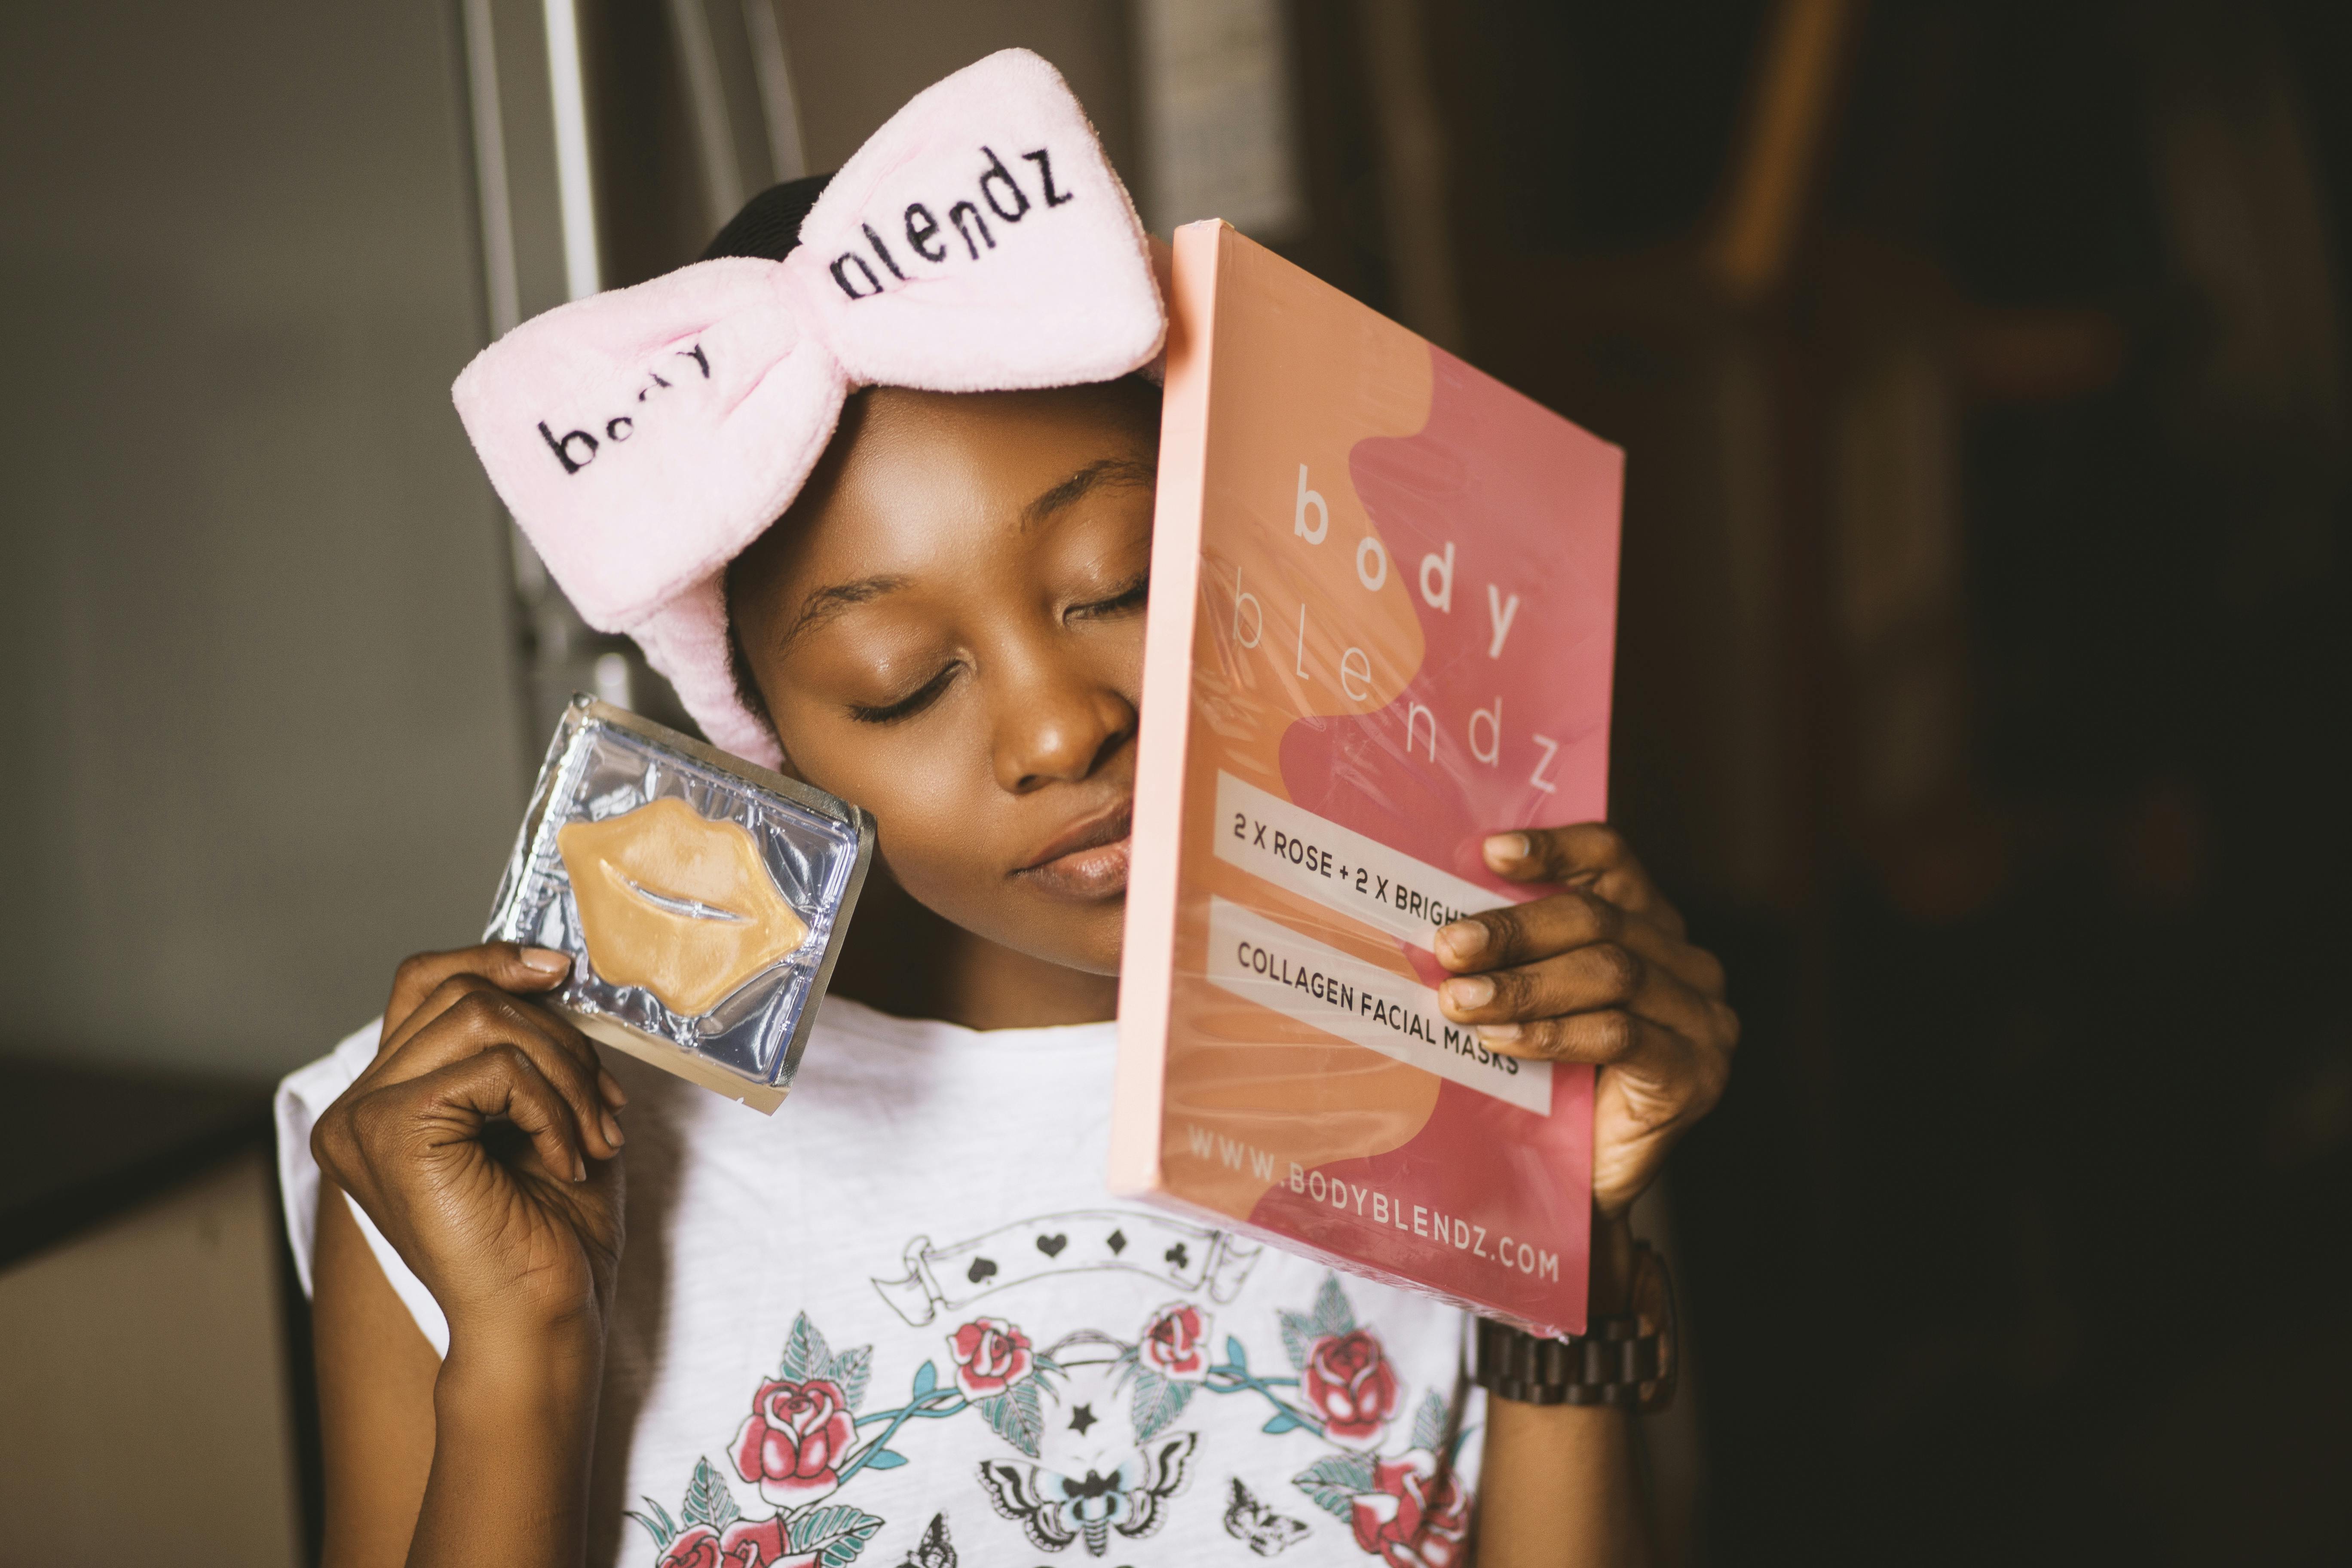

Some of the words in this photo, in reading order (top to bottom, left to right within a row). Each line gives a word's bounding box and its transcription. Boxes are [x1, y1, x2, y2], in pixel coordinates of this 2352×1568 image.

[1294, 463, 1520, 658] body
[1232, 566, 1559, 793] blendz
[1234, 812, 1246, 839] 2
[1253, 821, 1267, 849] X
[1274, 830, 1332, 878] ROSE
[1339, 865, 1348, 880] +
[1356, 867, 1368, 894] 2
[1375, 875, 1389, 903] X
[1396, 884, 1468, 926] BRIGH
[1238, 942, 1354, 1011] COLLAGEN
[1361, 992, 1436, 1044] FACIAL
[1188, 1124, 1560, 1283] WWW.BODYBLENDZ.COM
